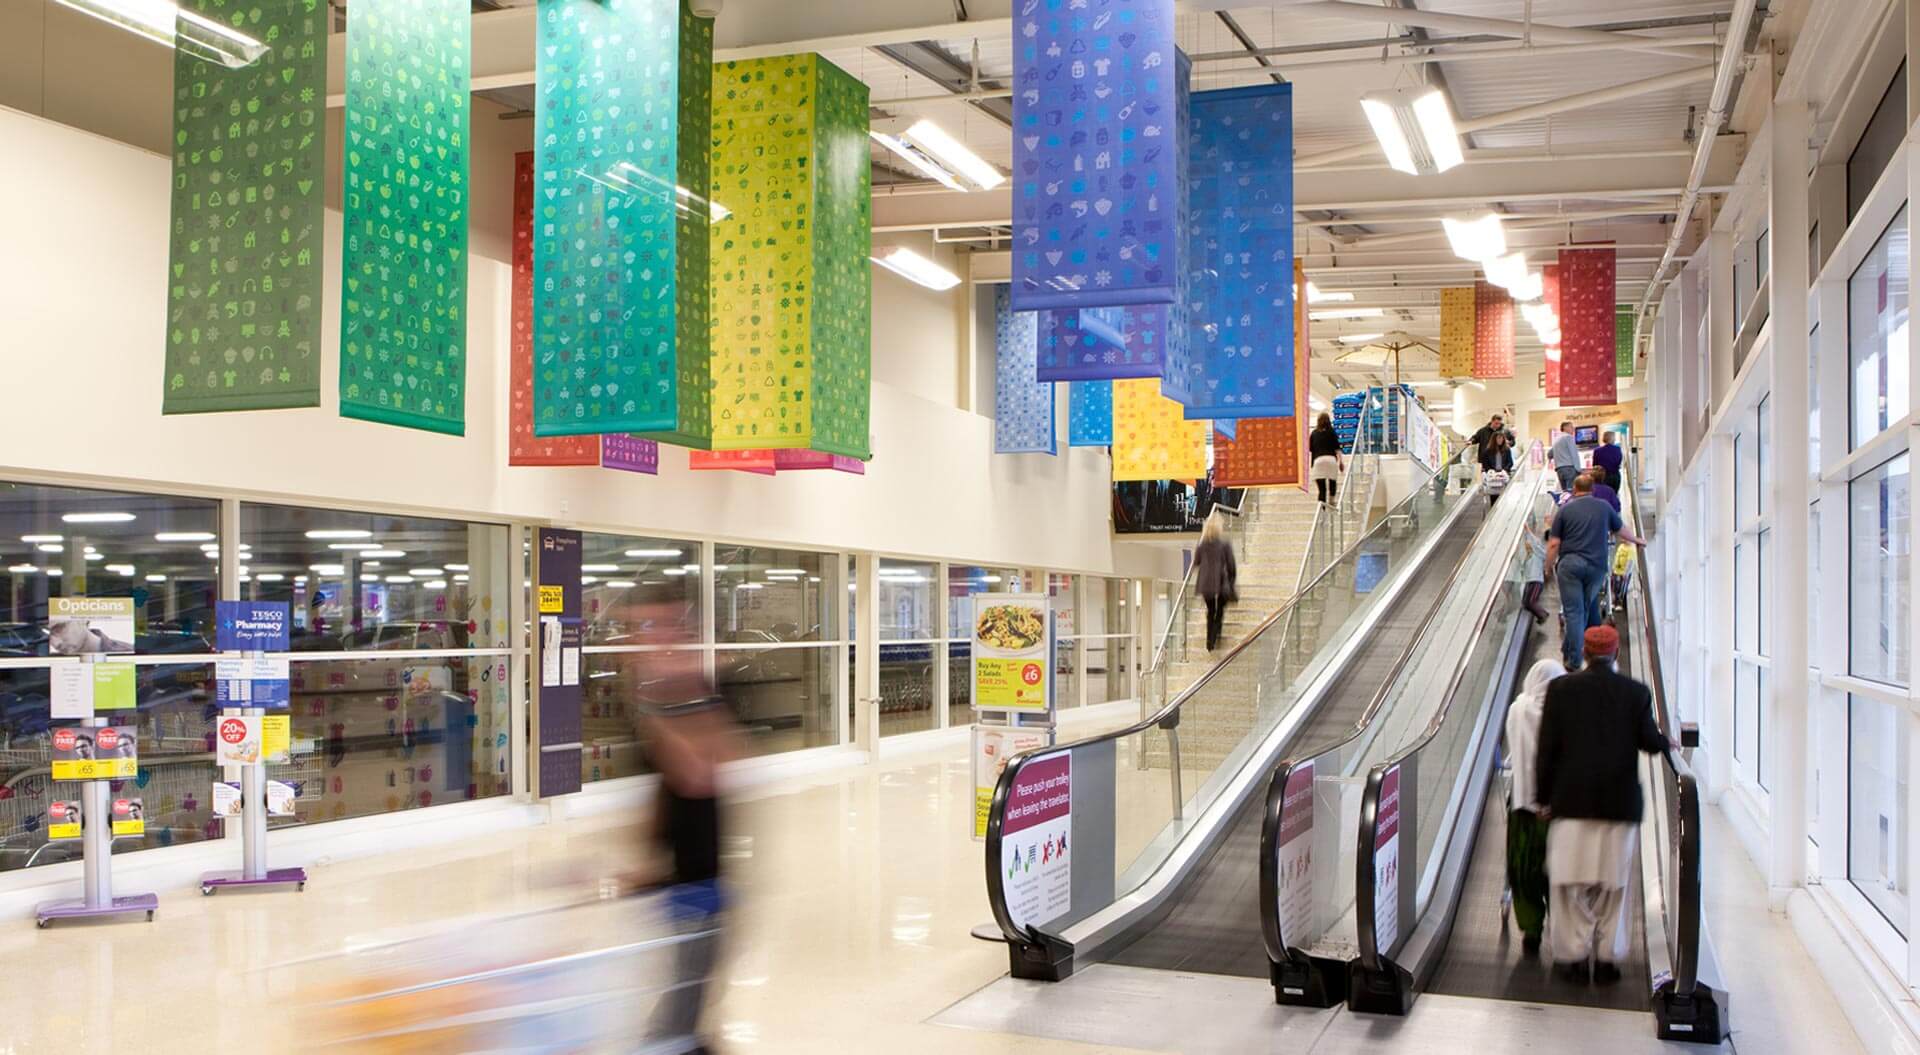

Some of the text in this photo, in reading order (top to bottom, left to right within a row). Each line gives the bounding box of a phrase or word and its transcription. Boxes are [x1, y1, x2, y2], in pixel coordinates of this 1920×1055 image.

[58, 597, 125, 614] Opticians
[235, 620, 282, 631] Pharmacy
[1025, 669, 1039, 681] £6
[223, 722, 245, 734] 20%
[1016, 783, 1033, 797] Please
[1033, 778, 1046, 795] push
[1056, 772, 1070, 786] trolley
[1007, 806, 1022, 820] when
[1022, 800, 1040, 816] leaving
